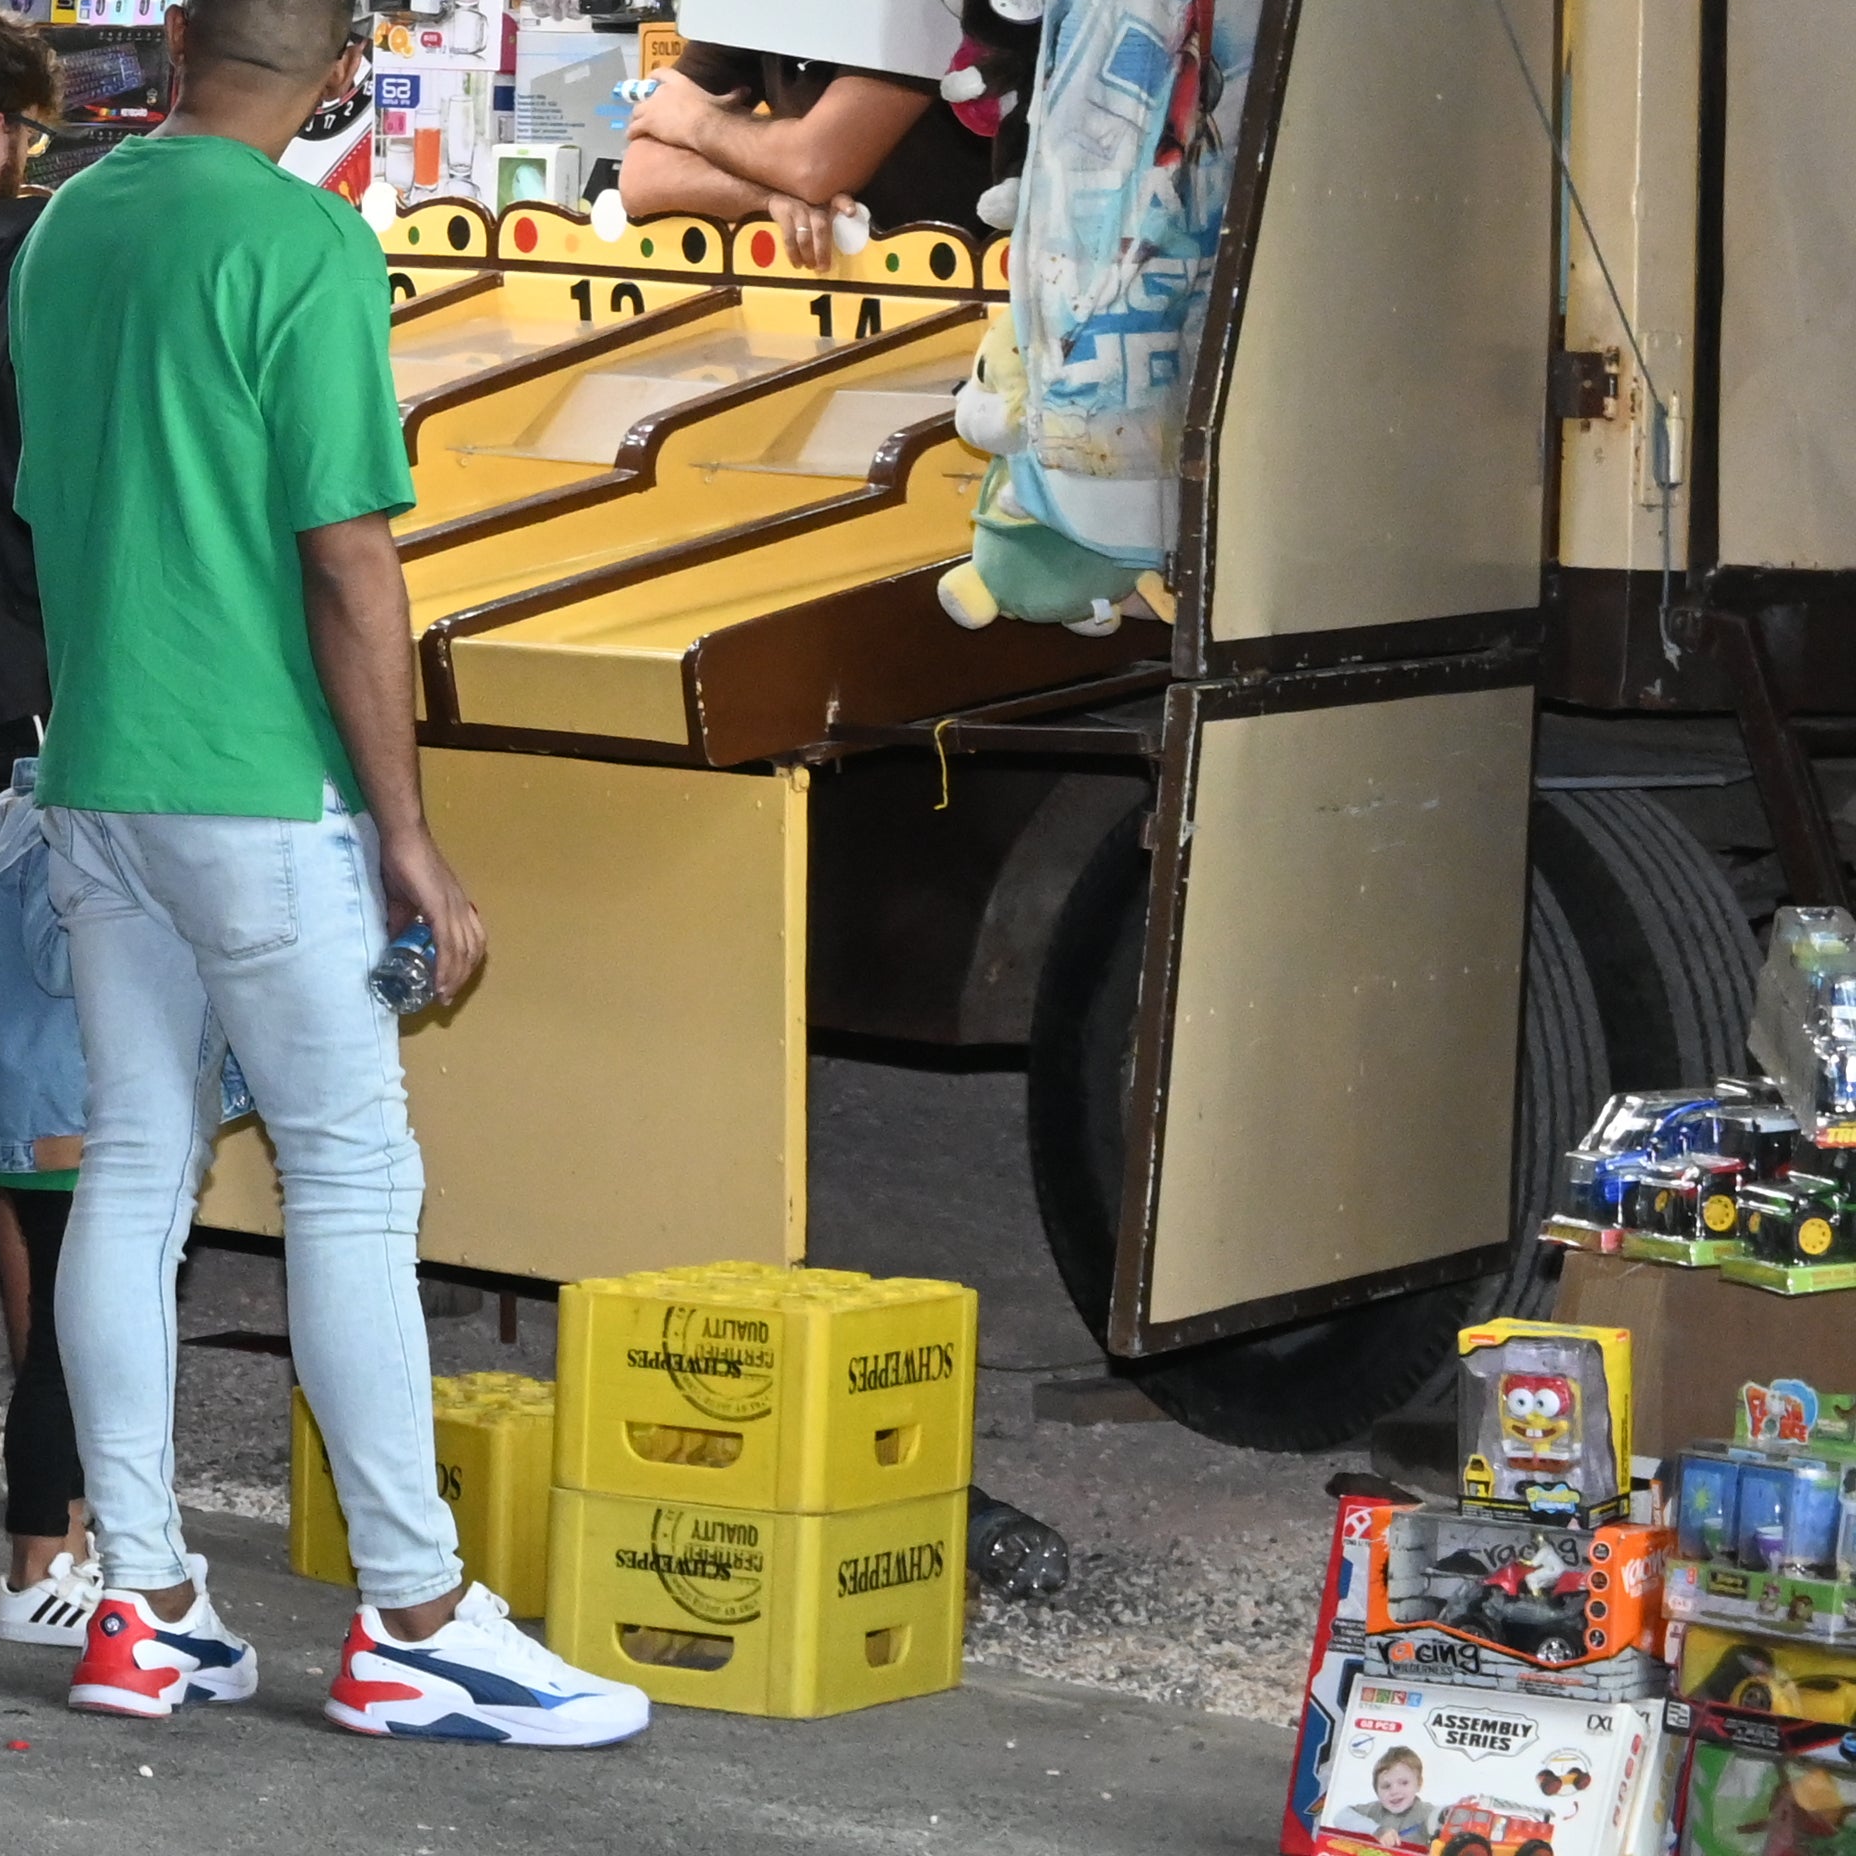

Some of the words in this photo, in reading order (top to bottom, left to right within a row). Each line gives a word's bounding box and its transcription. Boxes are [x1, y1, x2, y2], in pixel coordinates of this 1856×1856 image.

[702, 1315, 770, 1344] QUALITY
[627, 1348, 743, 1379] SCHWEPPES
[848, 1342, 956, 1395] SCHWEPPES
[690, 1518, 760, 1547] QUALITY
[615, 1548, 732, 1581] SCHWEPPES
[837, 1540, 946, 1598] SCHWEPPES
[1377, 1640, 1482, 1675] racing
[1431, 1713, 1533, 1738] ASSEMBLY
[1445, 1730, 1513, 1752] SERIES
